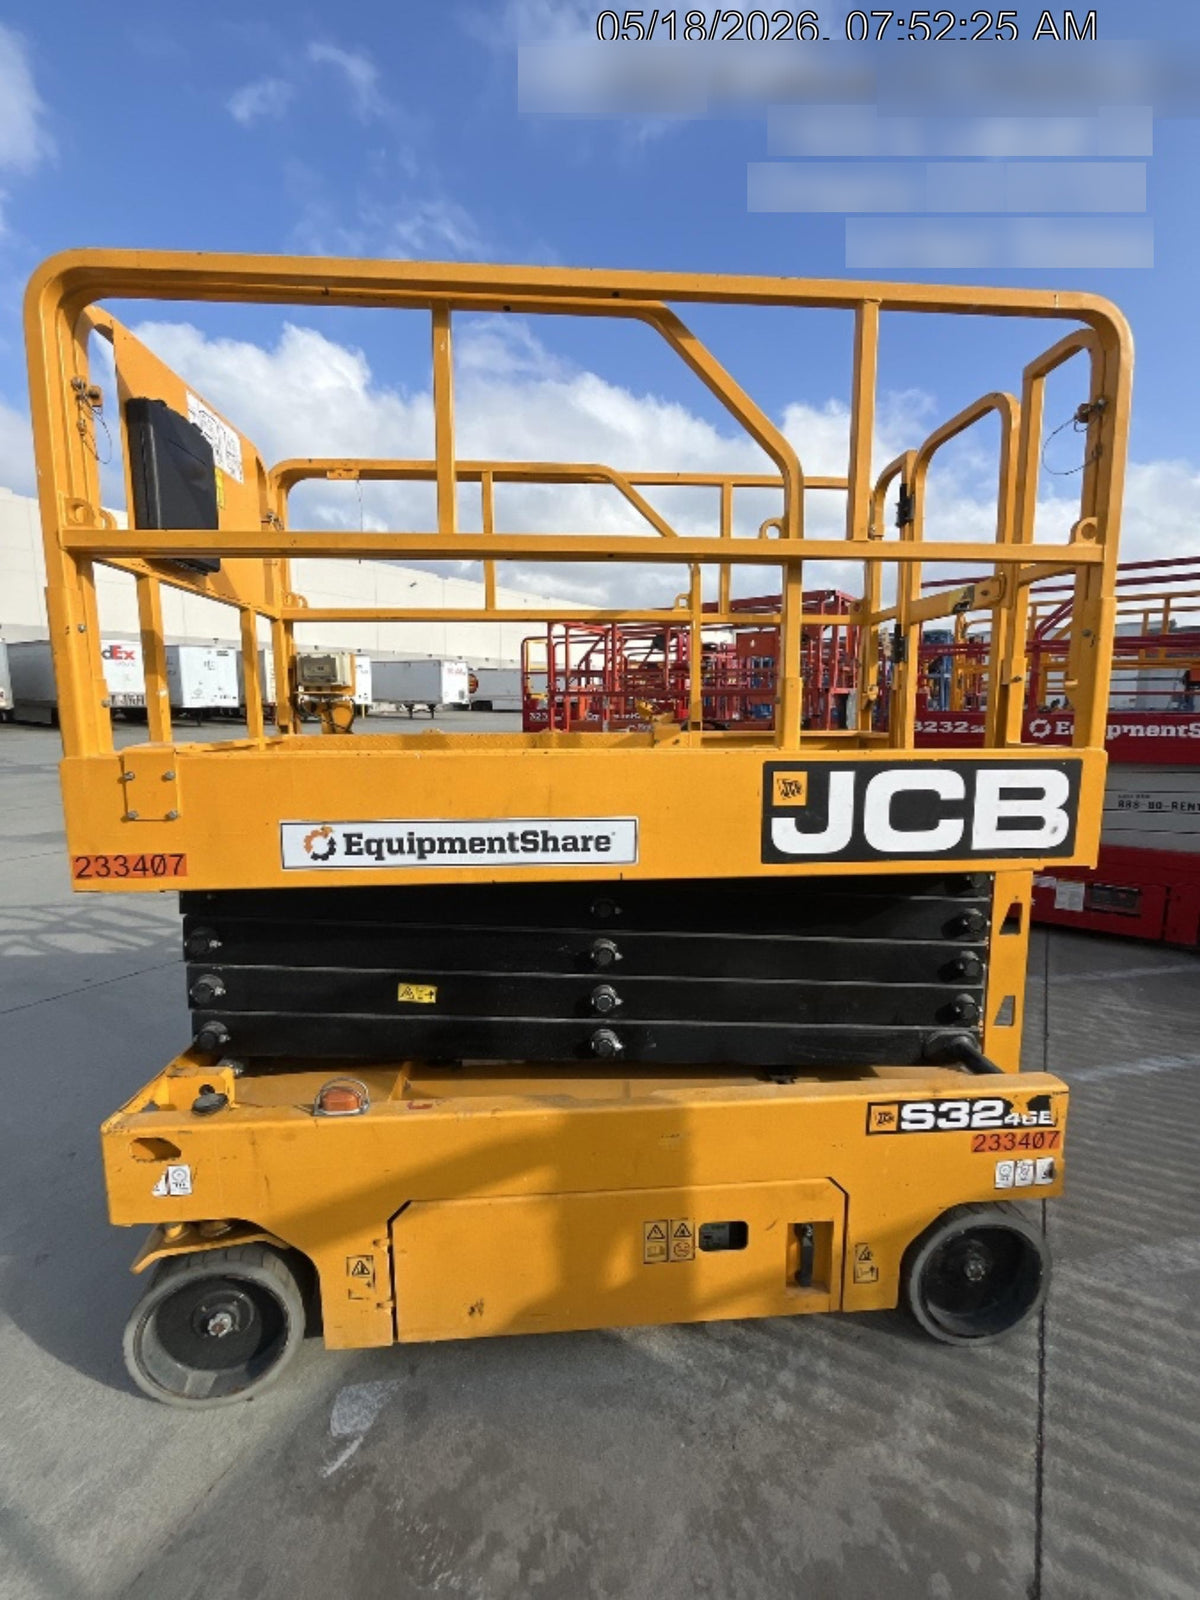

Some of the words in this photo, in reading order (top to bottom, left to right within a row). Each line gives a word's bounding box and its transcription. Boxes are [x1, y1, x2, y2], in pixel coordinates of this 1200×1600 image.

[100, 645, 136, 660] dEx
[771, 769, 1070, 853] JCB
[342, 829, 612, 861] EquipmentShare
[75, 853, 185, 879] 233407
[974, 1131, 1060, 1152] 233407
